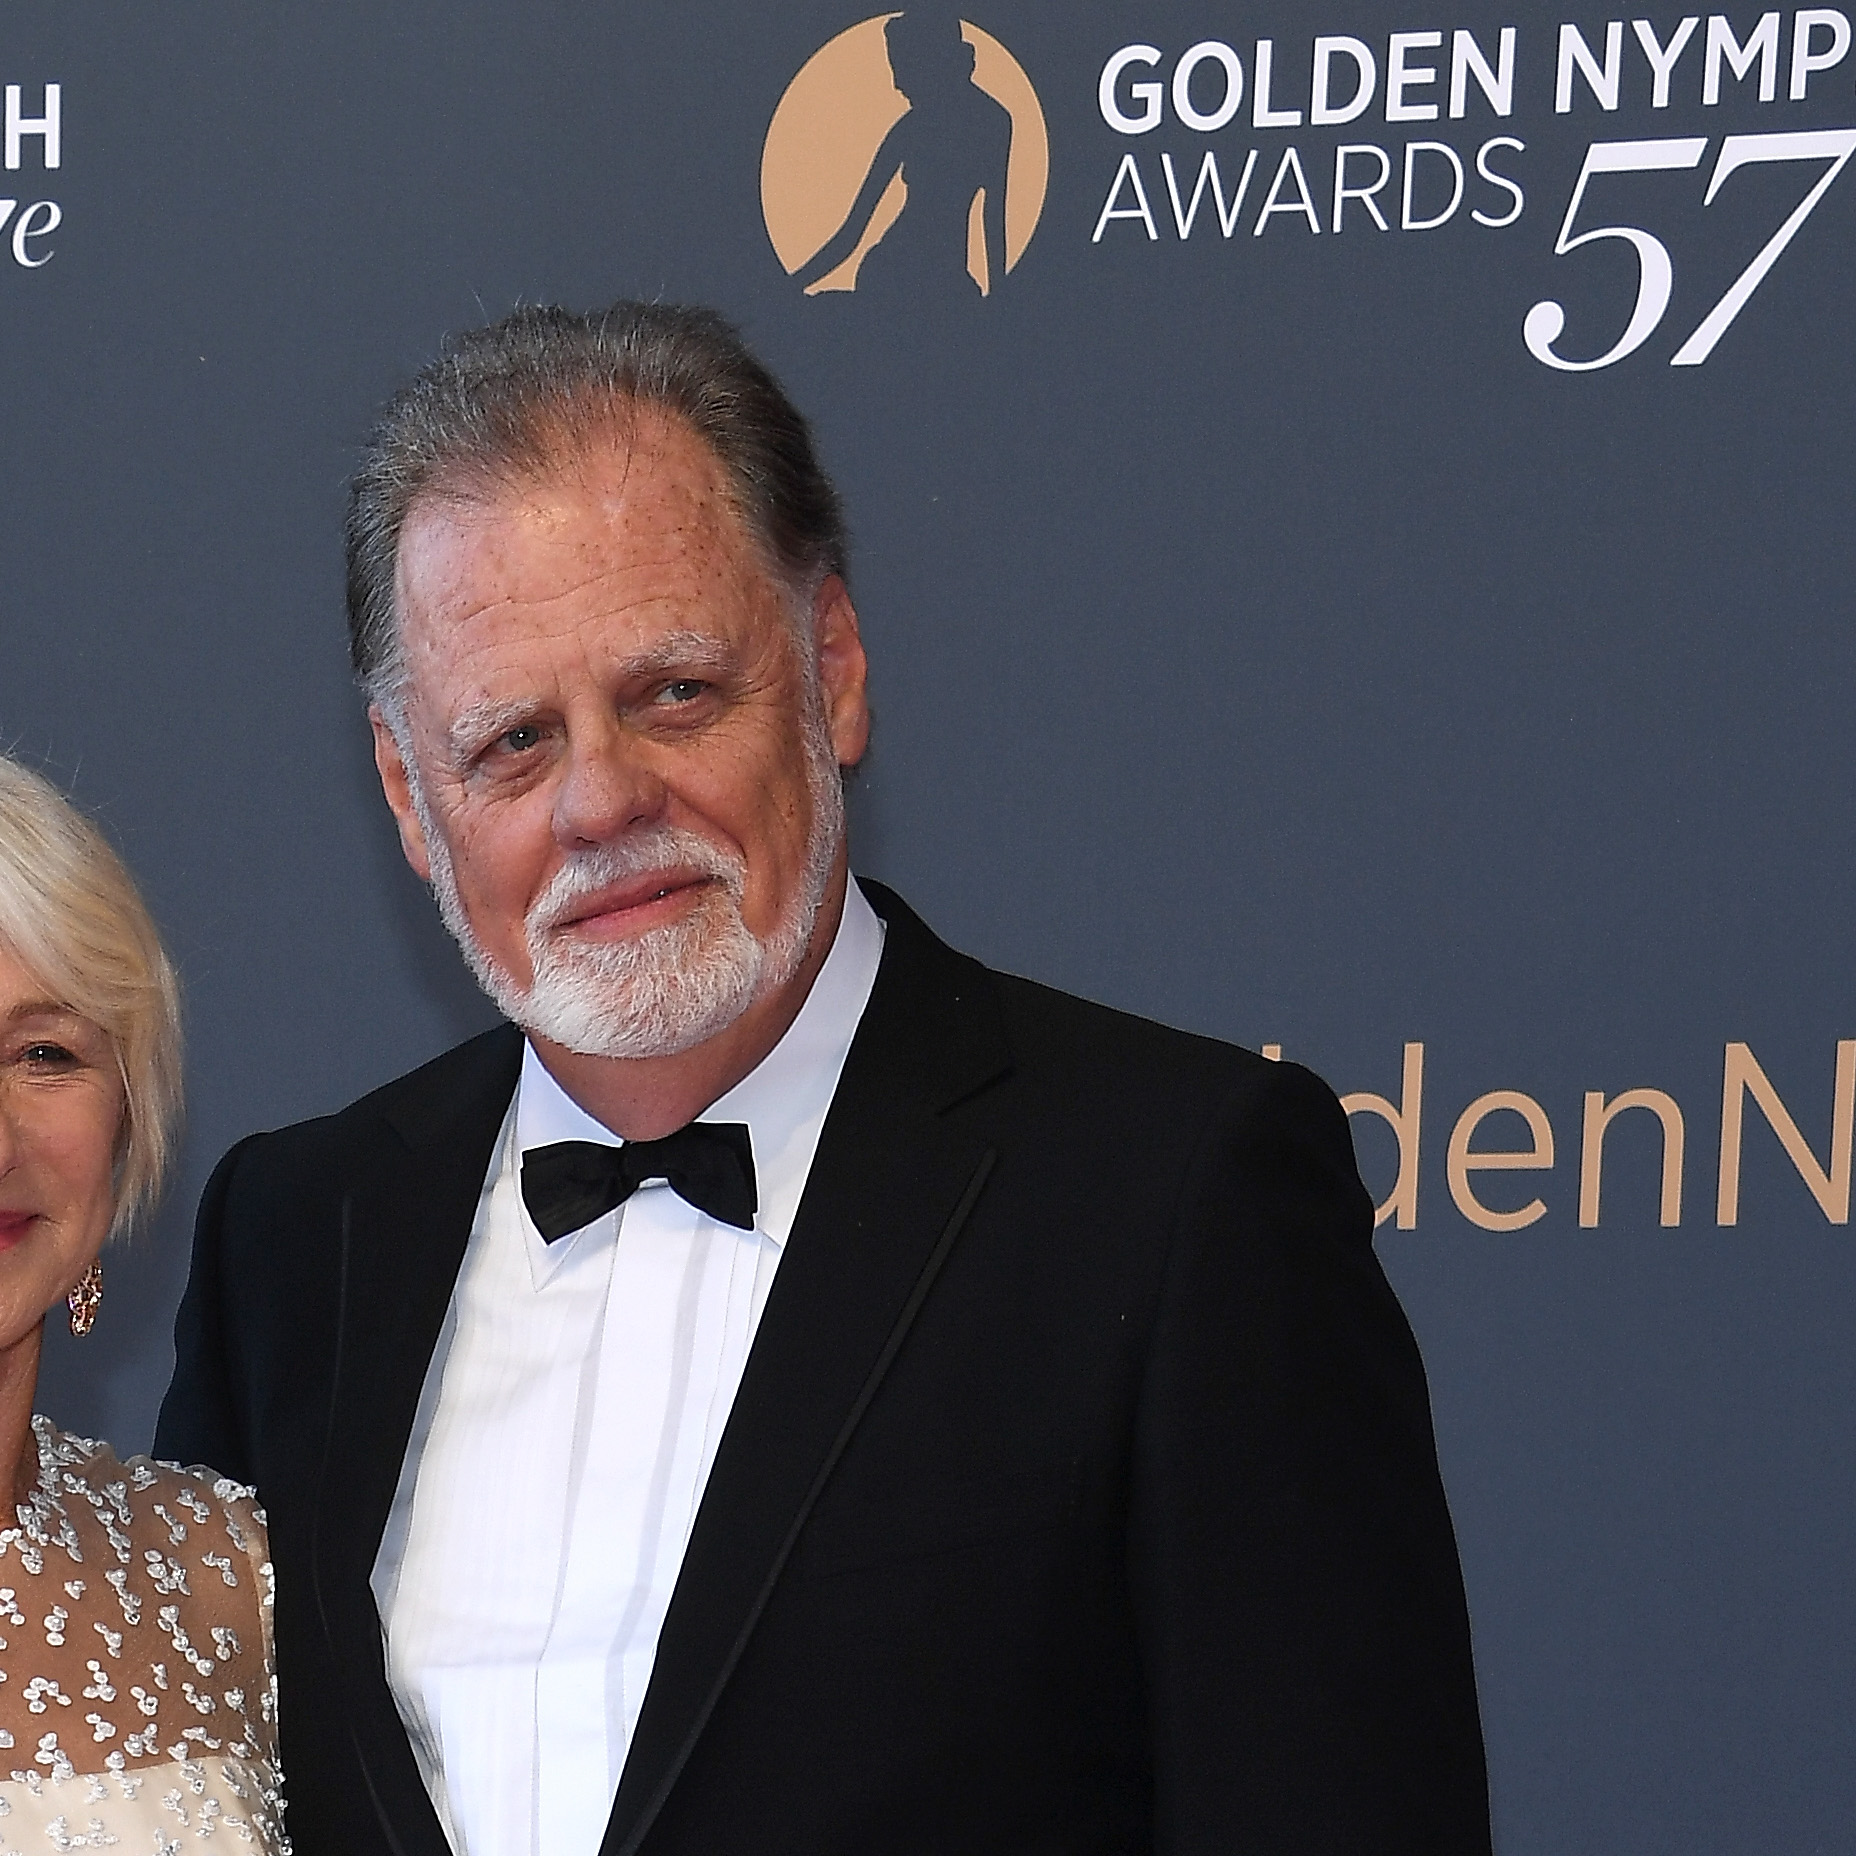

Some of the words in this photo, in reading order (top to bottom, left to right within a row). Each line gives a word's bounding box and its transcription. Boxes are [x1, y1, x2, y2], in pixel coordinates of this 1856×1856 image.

[1098, 27, 1517, 135] GOLDEN
[1091, 136, 1525, 243] AWARDS
[1260, 1040, 1856, 1232] denN
